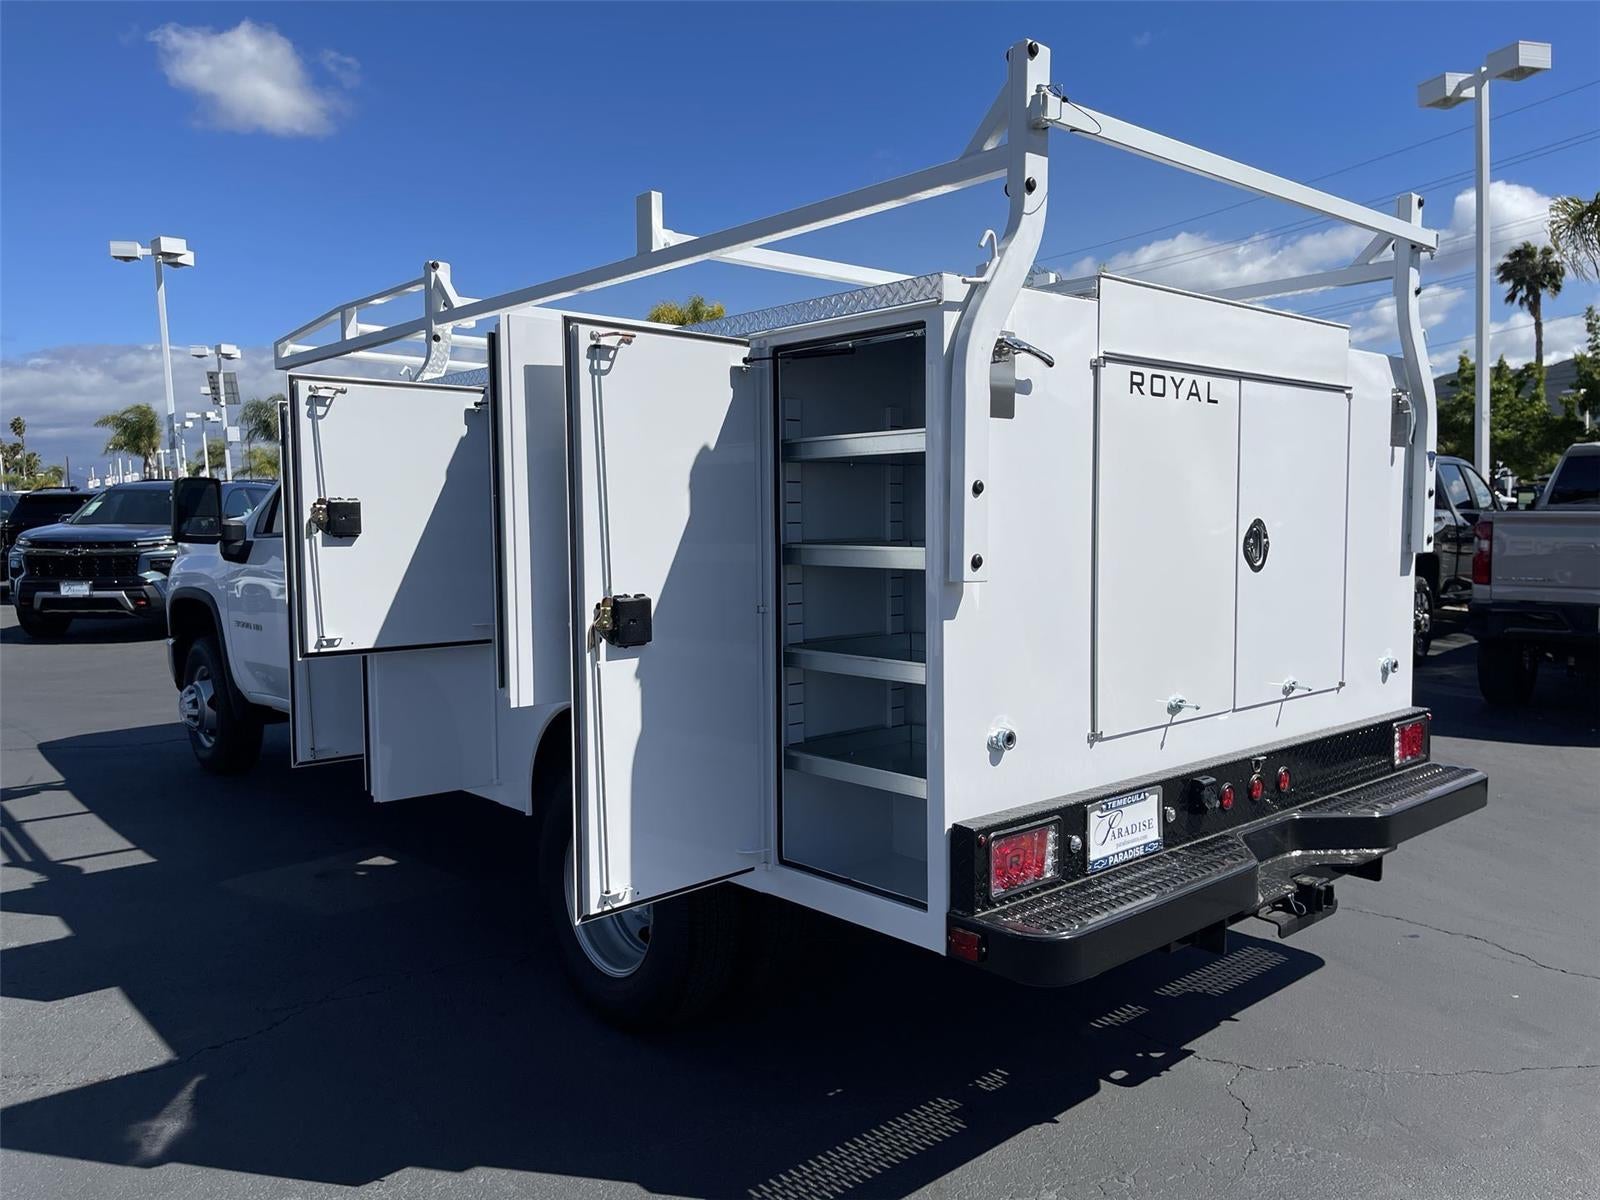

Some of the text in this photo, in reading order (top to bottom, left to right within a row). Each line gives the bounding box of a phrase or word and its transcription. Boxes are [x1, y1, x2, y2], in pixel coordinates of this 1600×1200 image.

[1130, 370, 1218, 404] ROYAL
[1107, 792, 1145, 809] TEMECULA
[1094, 809, 1154, 846] PARADISE
[1108, 845, 1145, 866] PARADISE
